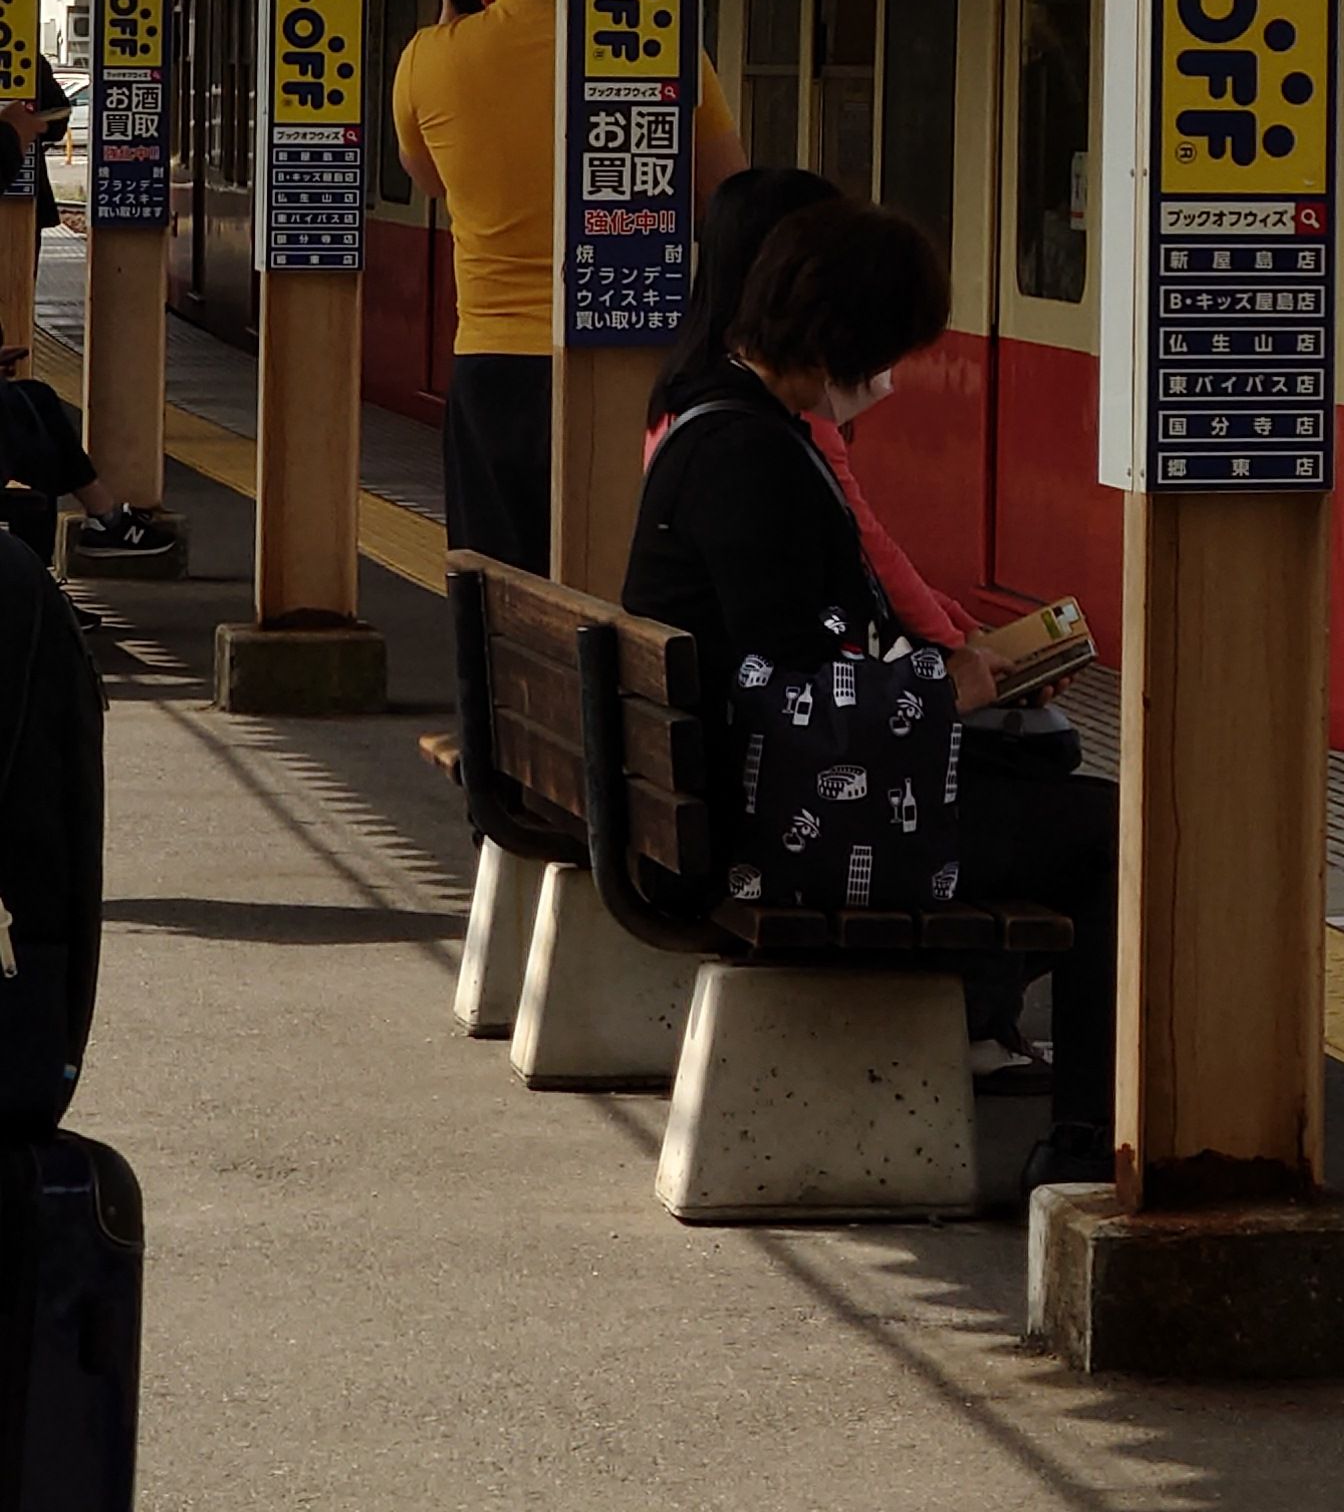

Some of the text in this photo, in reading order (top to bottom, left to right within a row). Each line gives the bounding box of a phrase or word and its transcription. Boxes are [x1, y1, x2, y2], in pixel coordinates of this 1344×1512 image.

[588, 111, 676, 152] お酒
[586, 155, 675, 197] 買取
[1167, 209, 1288, 228] ブックオフウィズ
[577, 267, 683, 286] ブランデー
[577, 289, 682, 307] ウイスキー
[576, 311, 682, 331] 買い取ります
[1168, 374, 1315, 394] 東バイパス店
